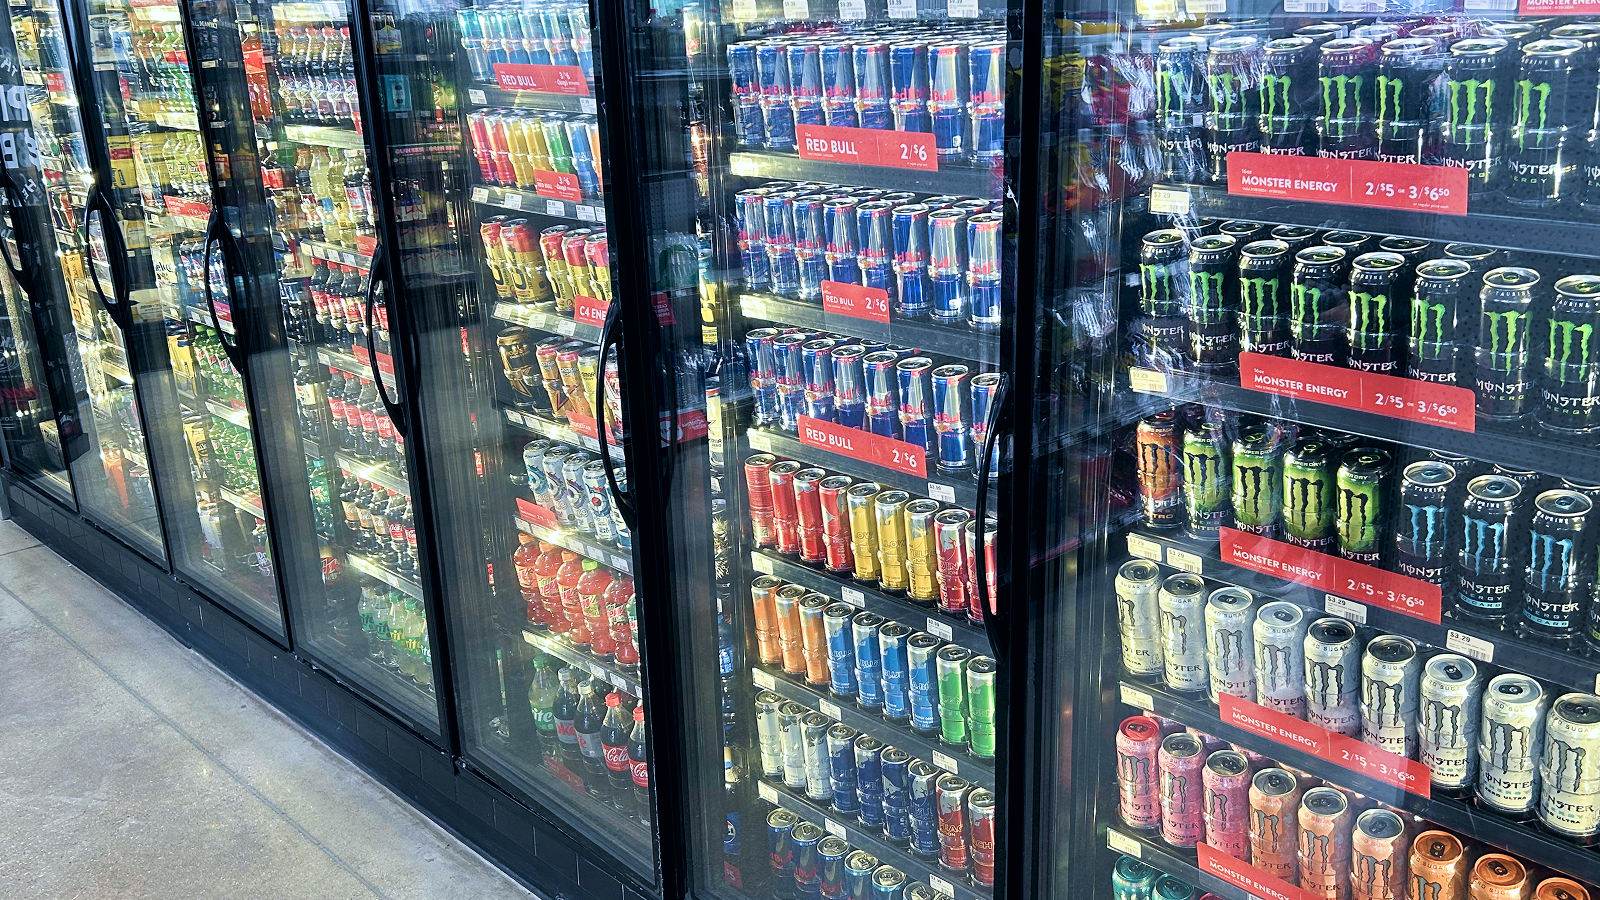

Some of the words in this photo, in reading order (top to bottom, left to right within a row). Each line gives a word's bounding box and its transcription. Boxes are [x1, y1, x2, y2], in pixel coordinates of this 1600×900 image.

[501, 74, 517, 86] RED
[518, 75, 537, 87] BULL
[805, 138, 828, 152] RED
[830, 139, 858, 155] BULL
[899, 143, 927, 161] 2/$6
[1158, 137, 1202, 151] ONSTER
[1260, 144, 1306, 156] NSTER
[1508, 157, 1558, 176] ONSTER
[1241, 175, 1292, 189] MONSTER
[1294, 179, 1338, 193] ENERGY
[1364, 182, 1395, 198] 2/$5
[1509, 174, 1548, 184] ERGY
[825, 295, 839, 304] RED
[839, 297, 855, 307] BULL
[865, 297, 887, 312] 2/$6
[579, 305, 590, 317] C4
[591, 306, 607, 320] ENE
[1142, 322, 1185, 337] NSTER
[1240, 339, 1291, 354] NSTER
[1291, 346, 1335, 362] NSTER
[1347, 356, 1398, 372] ONSTER
[1408, 363, 1457, 382] ONSTER
[1254, 374, 1304, 391] MONSTER
[1305, 383, 1349, 399] ENERGY
[1375, 393, 1404, 409] 2/$5
[1475, 377, 1537, 394] MONSTE
[1482, 392, 1525, 401] ENERG
[1541, 386, 1600, 407] ONSTER
[1546, 403, 1592, 415] NERGY
[805, 428, 827, 443] RED
[828, 433, 854, 451] BULL
[891, 448, 918, 468] 2/$6
[1472, 499, 1500, 509] AURINE
[1188, 507, 1233, 520] NSTER
[1539, 510, 1570, 525] AURINE
[1234, 517, 1279, 534] MONSTE
[1340, 546, 1381, 561] NSTER
[1233, 549, 1280, 569] MONSTER
[1281, 563, 1322, 581] ENERGY
[1347, 579, 1375, 596] 2/$5
[1398, 559, 1452, 577] MONSTE
[1458, 576, 1512, 594] ONSTER
[1327, 595, 1346, 606] $3.29
[1462, 588, 1503, 600] NERGY
[1522, 592, 1580, 613] ONSTER
[1525, 606, 1570, 620] NERGY
[1450, 630, 1471, 643] $3.29
[1122, 642, 1151, 657] STER
[1166, 659, 1202, 672] NSTER
[1210, 673, 1256, 689] ONSTER
[1439, 684, 1461, 692] SUGA
[1258, 691, 1304, 706] ONSTER
[532, 708, 553, 722] ite
[1308, 708, 1356, 724] ONSTER
[1508, 705, 1525, 714] SUG
[1362, 726, 1412, 744] ONSTER
[1565, 722, 1590, 733] SUGA
[1232, 711, 1277, 734] MONSTER
[1279, 728, 1318, 748] ENERGY
[1341, 749, 1368, 767] 2/$5
[1421, 748, 1470, 767] ONSTER
[634, 762, 648, 778] Co
[1484, 771, 1537, 790] ONSTER
[1503, 793, 1527, 801] ULTRA
[1542, 791, 1595, 813] ONSTER
[1163, 812, 1199, 830] NSTER
[1556, 812, 1581, 825] ULTRA
[1206, 833, 1241, 849] NSTER
[1253, 852, 1291, 869] NSTER
[1209, 860, 1252, 886] MONSTER
[1253, 881, 1290, 900] ENERGY
[1300, 875, 1341, 891] ONSTER
[1488, 887, 1512, 897] SUGA
